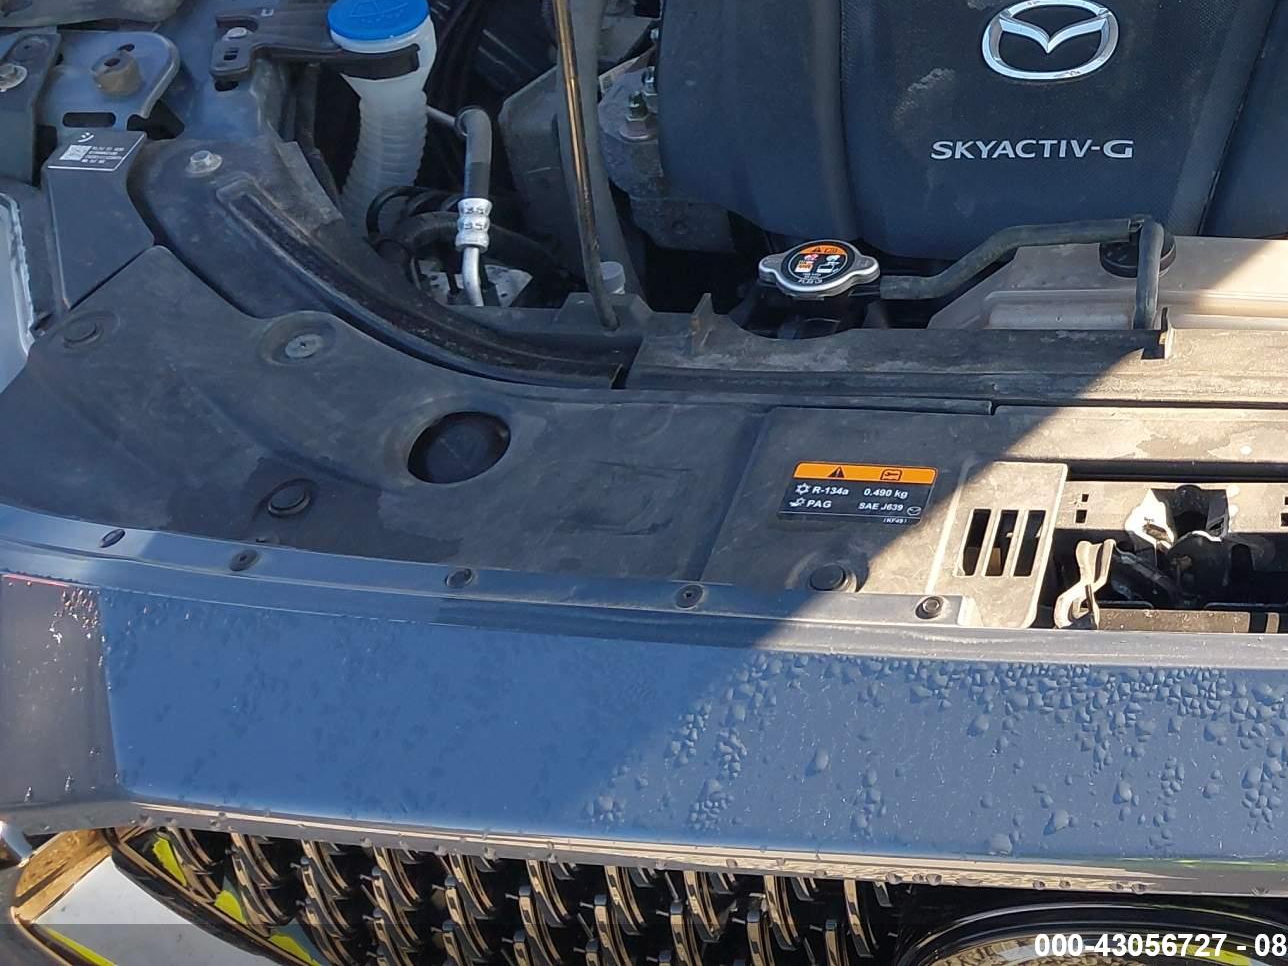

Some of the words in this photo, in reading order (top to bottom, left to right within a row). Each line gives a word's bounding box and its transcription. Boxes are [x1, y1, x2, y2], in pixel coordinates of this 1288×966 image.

[930, 139, 1134, 160] SKYACTIV-G
[811, 486, 850, 495] R-134a
[863, 488, 893, 497] 0.490
[893, 489, 909, 500] kg
[805, 499, 833, 509] PAG
[858, 502, 880, 510] SAE
[880, 503, 905, 512] J639
